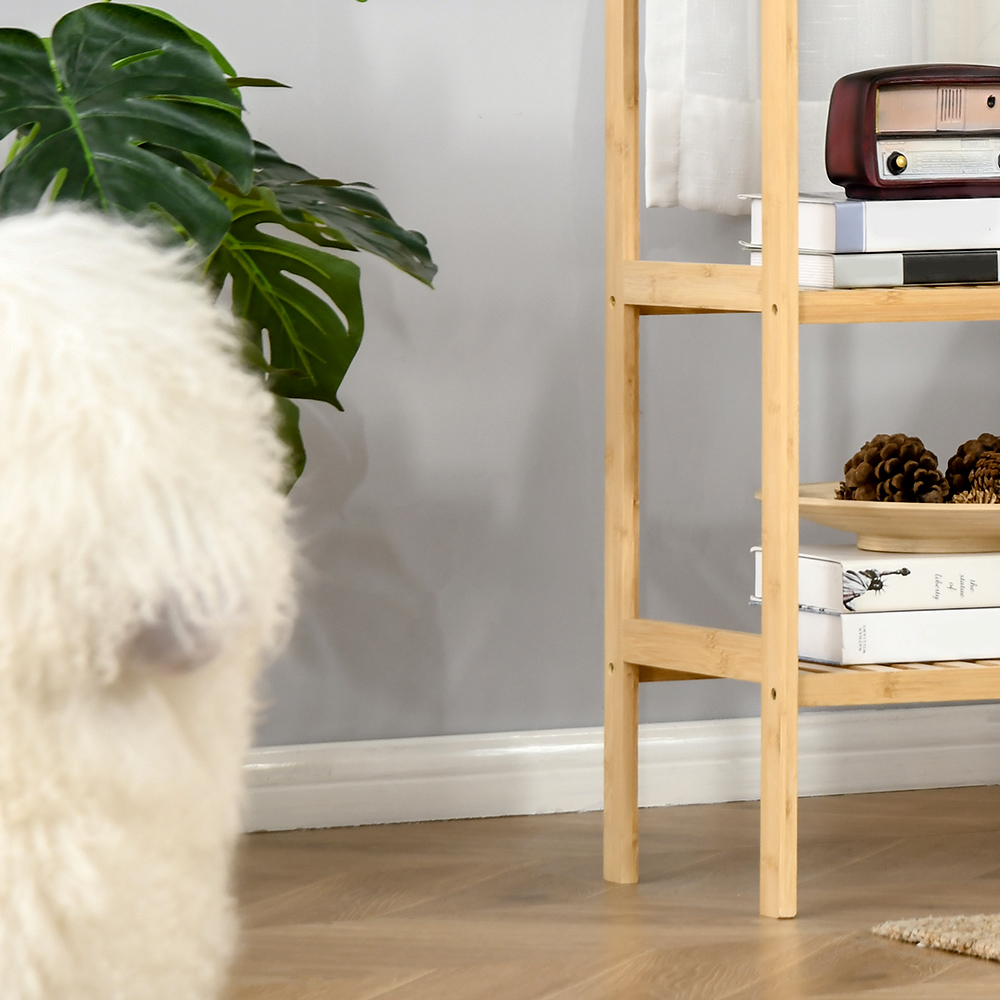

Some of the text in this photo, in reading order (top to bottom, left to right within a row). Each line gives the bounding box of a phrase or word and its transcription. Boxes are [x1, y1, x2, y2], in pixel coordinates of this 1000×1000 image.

[932, 573, 943, 600] liberty
[946, 581, 957, 591] of
[969, 579, 978, 593] the
